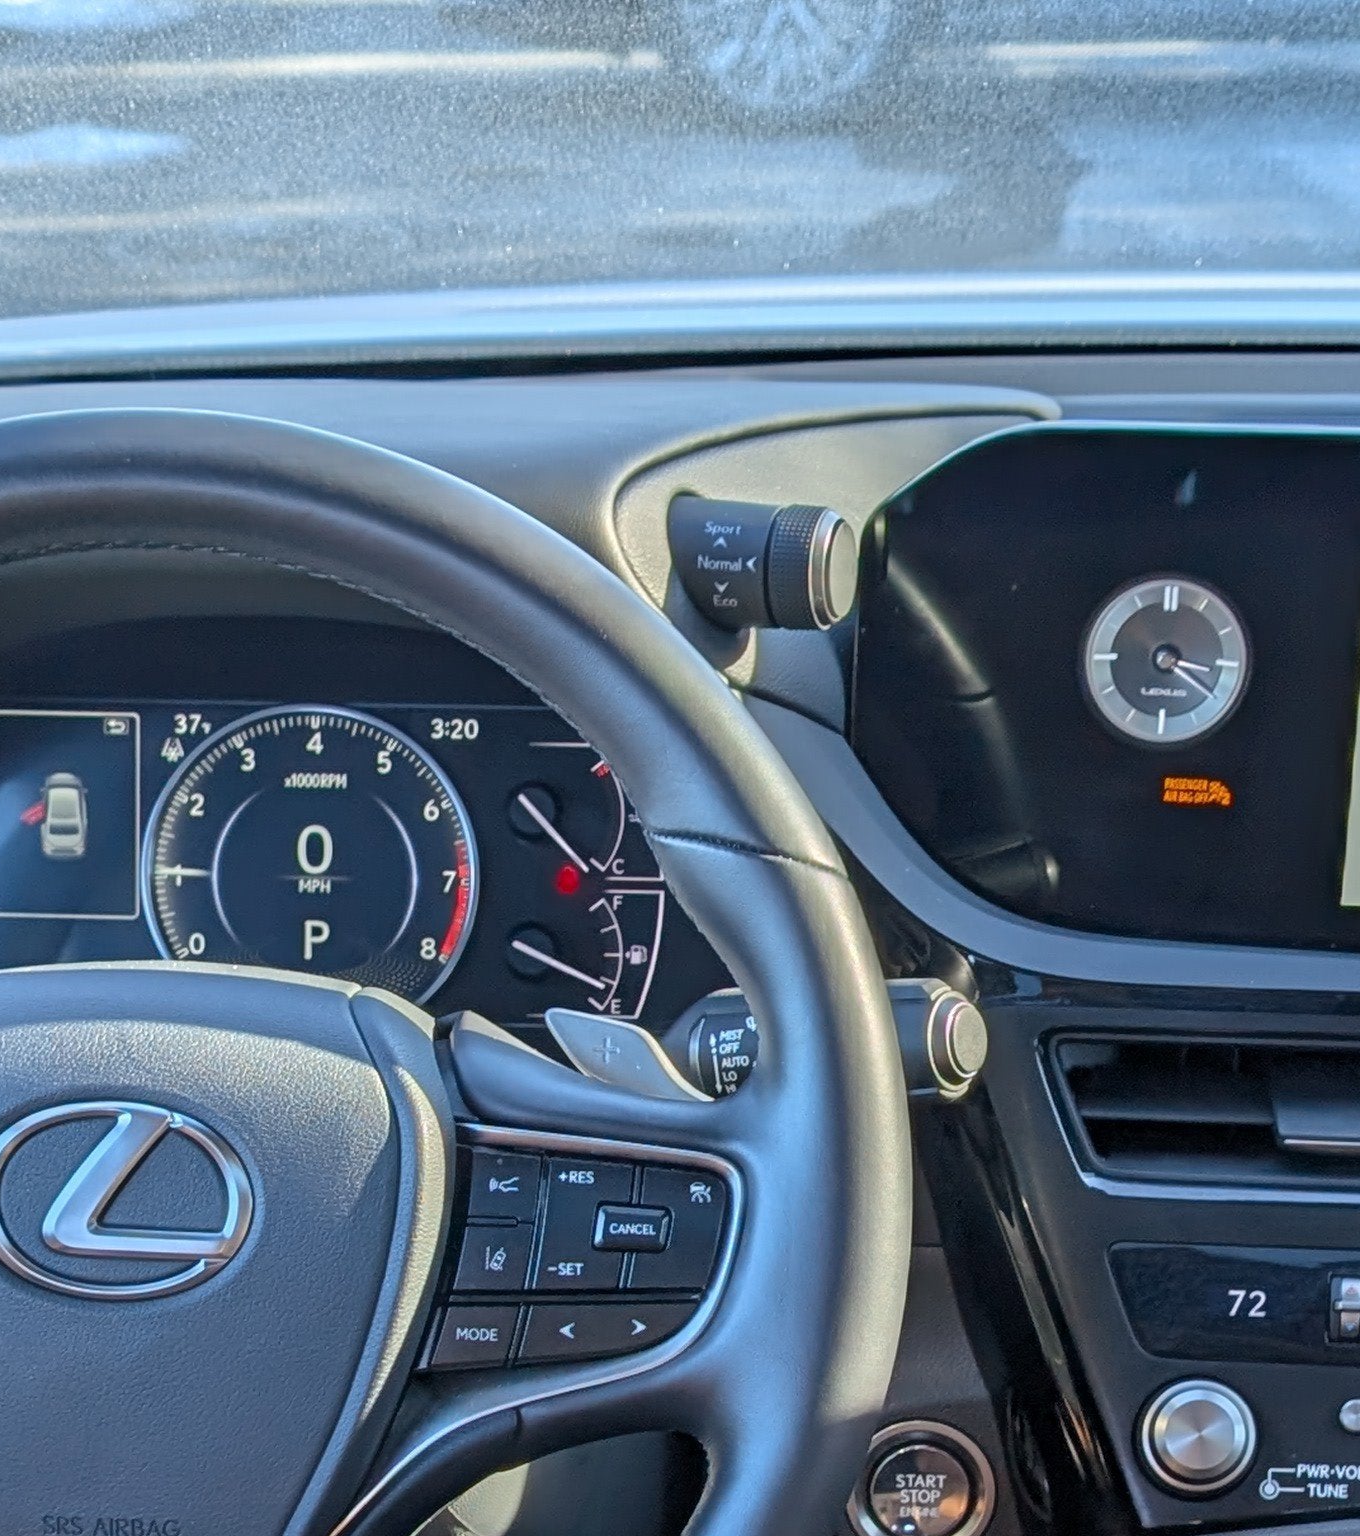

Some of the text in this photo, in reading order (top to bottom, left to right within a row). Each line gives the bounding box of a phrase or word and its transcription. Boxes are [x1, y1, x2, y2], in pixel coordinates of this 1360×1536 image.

[704, 520, 742, 536] Sport
[697, 554, 742, 572] Normal
[713, 594, 738, 608] Eco
[1140, 686, 1188, 699] LEXUS
[429, 717, 480, 741] 3:20
[305, 731, 324, 755] 4
[240, 748, 256, 772] 3
[377, 751, 392, 775] 5
[189, 792, 205, 818] 2
[423, 799, 441, 822] 6
[297, 824, 334, 875] 0
[611, 858, 625, 875] C
[297, 878, 332, 894] MPH
[442, 870, 457, 893] 7
[612, 895, 624, 911] F
[189, 932, 206, 955] 0
[303, 918, 331, 961] P
[419, 937, 437, 961] 8
[610, 998, 622, 1015] E
[718, 1041, 741, 1055] OFF
[721, 1055, 750, 1070] AUTO
[721, 1070, 738, 1082] LO
[609, 1222, 657, 1237] CANCEL
[1227, 1289, 1268, 1319] 72
[455, 1326, 499, 1343] MODE
[895, 1473, 948, 1489] START
[899, 1488, 941, 1504] STOP
[1307, 1482, 1349, 1499] TUNE
[41, 1514, 85, 1536] SRS
